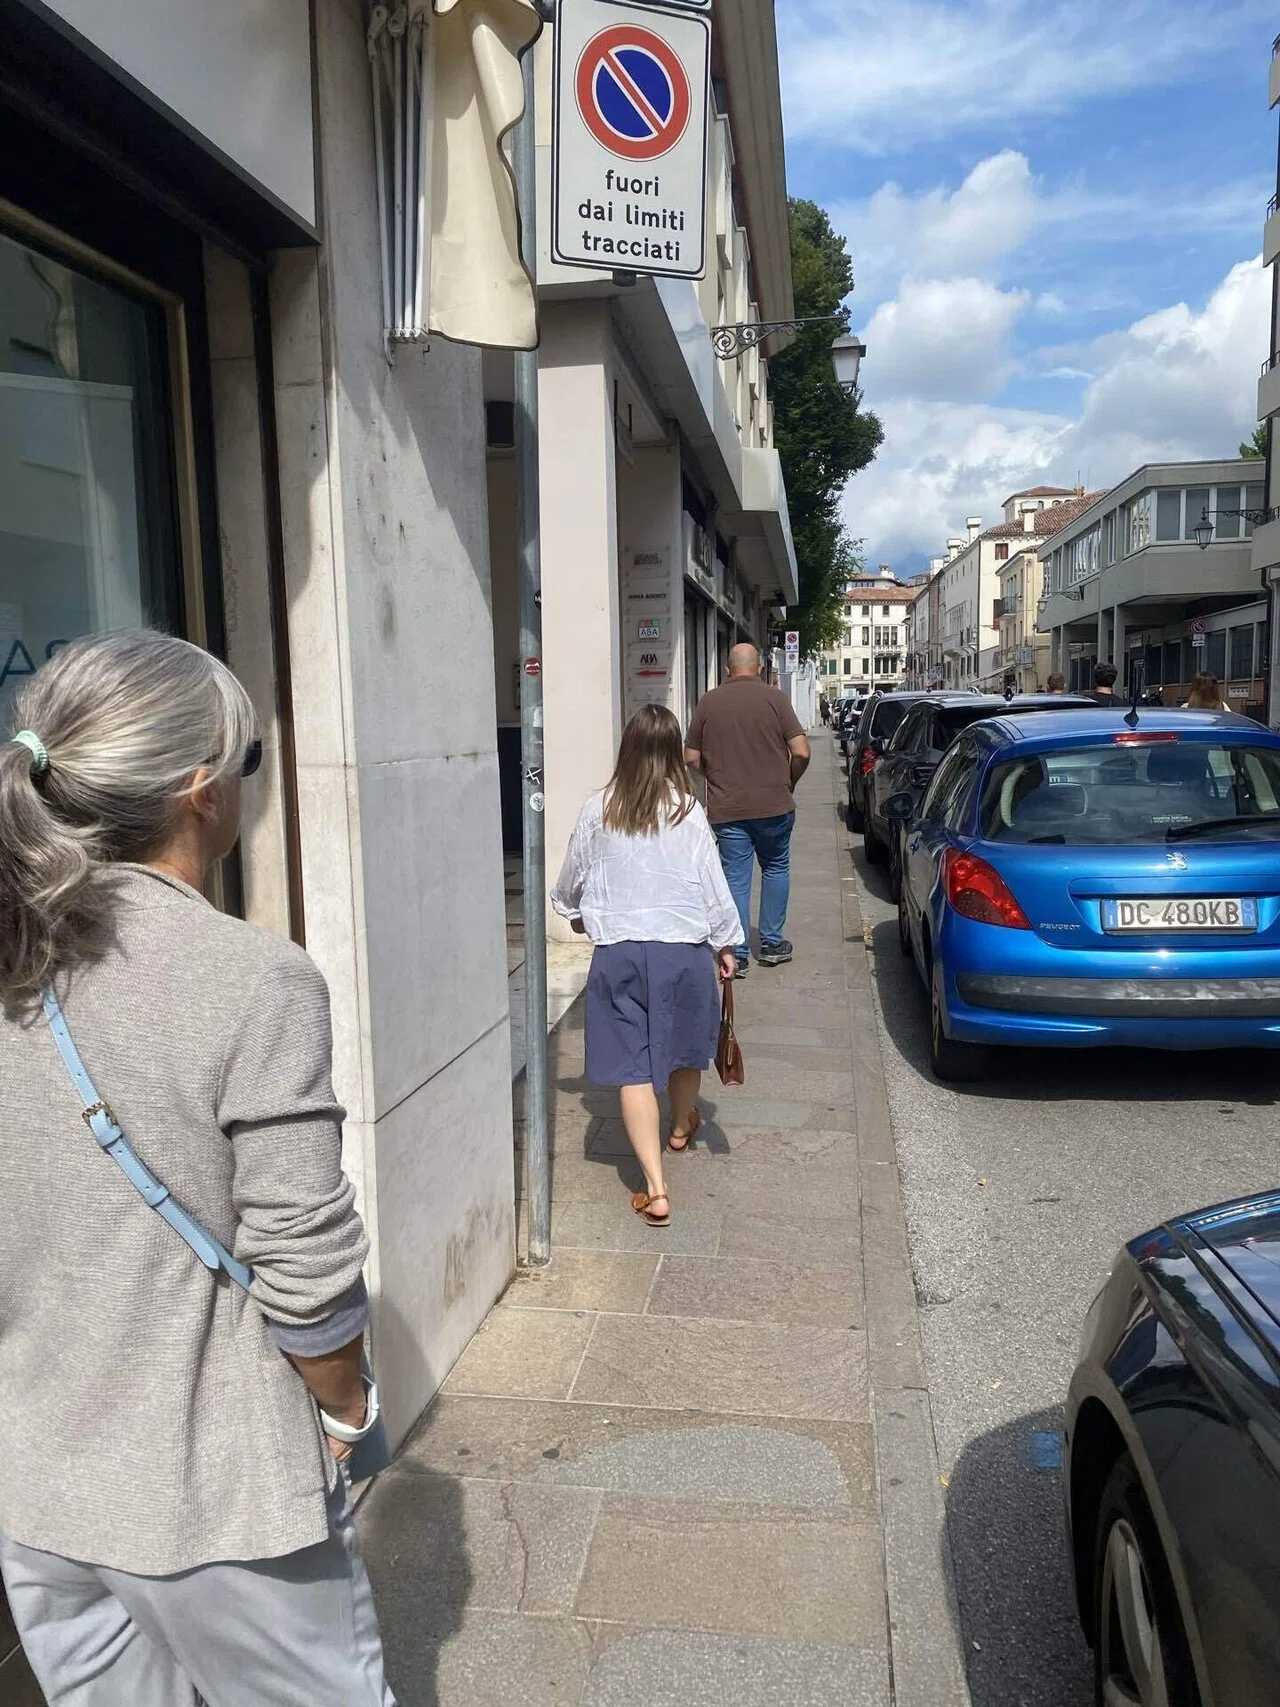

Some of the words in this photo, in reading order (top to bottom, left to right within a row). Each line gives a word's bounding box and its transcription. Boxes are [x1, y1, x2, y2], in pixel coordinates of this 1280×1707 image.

[605, 169, 660, 197] fuori
[578, 198, 613, 222] dai
[626, 204, 685, 231] limiti
[582, 230, 681, 261] tracciati
[641, 628, 657, 637] ABA
[1039, 922, 1081, 930] PEUGEOT
[1120, 902, 1151, 926] DC
[1161, 901, 1240, 925] 480KB
